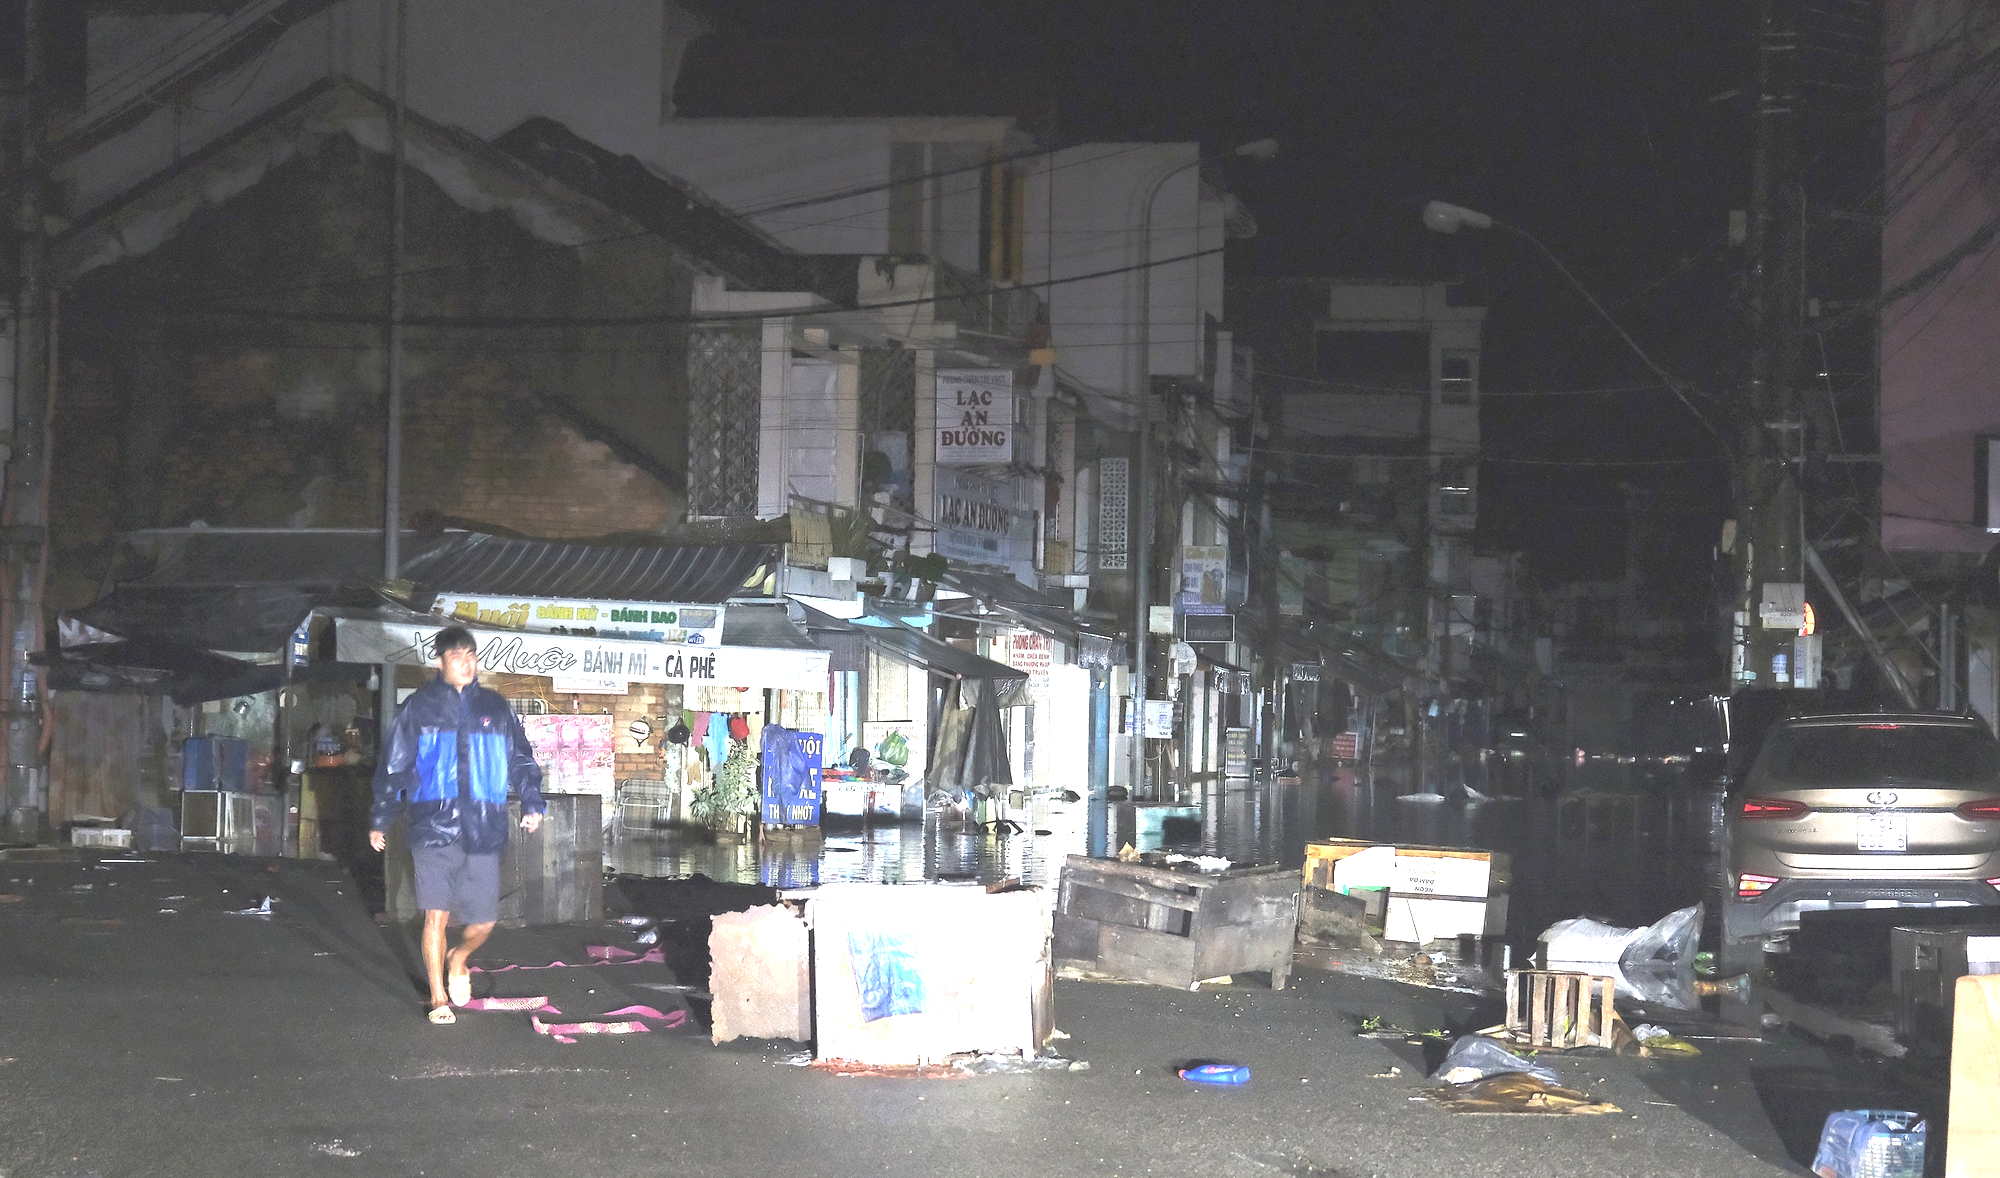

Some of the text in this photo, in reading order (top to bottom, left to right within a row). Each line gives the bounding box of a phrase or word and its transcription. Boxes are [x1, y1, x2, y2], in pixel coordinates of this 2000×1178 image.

[956, 390, 992, 409] LẠC
[960, 411, 988, 426] AN
[941, 426, 1006, 446] ĐƯỜNG
[940, 494, 960, 528] LẠC
[962, 499, 977, 528] AN
[536, 604, 574, 620] BÁNH
[610, 607, 648, 623] BÁNH
[651, 611, 677, 624] BAO
[583, 645, 623, 674] BÁNH
[628, 648, 647, 675] MÌ
[665, 650, 684, 678] CÀ
[689, 652, 716, 679] PHÊ
[791, 801, 814, 821] NHỚT
